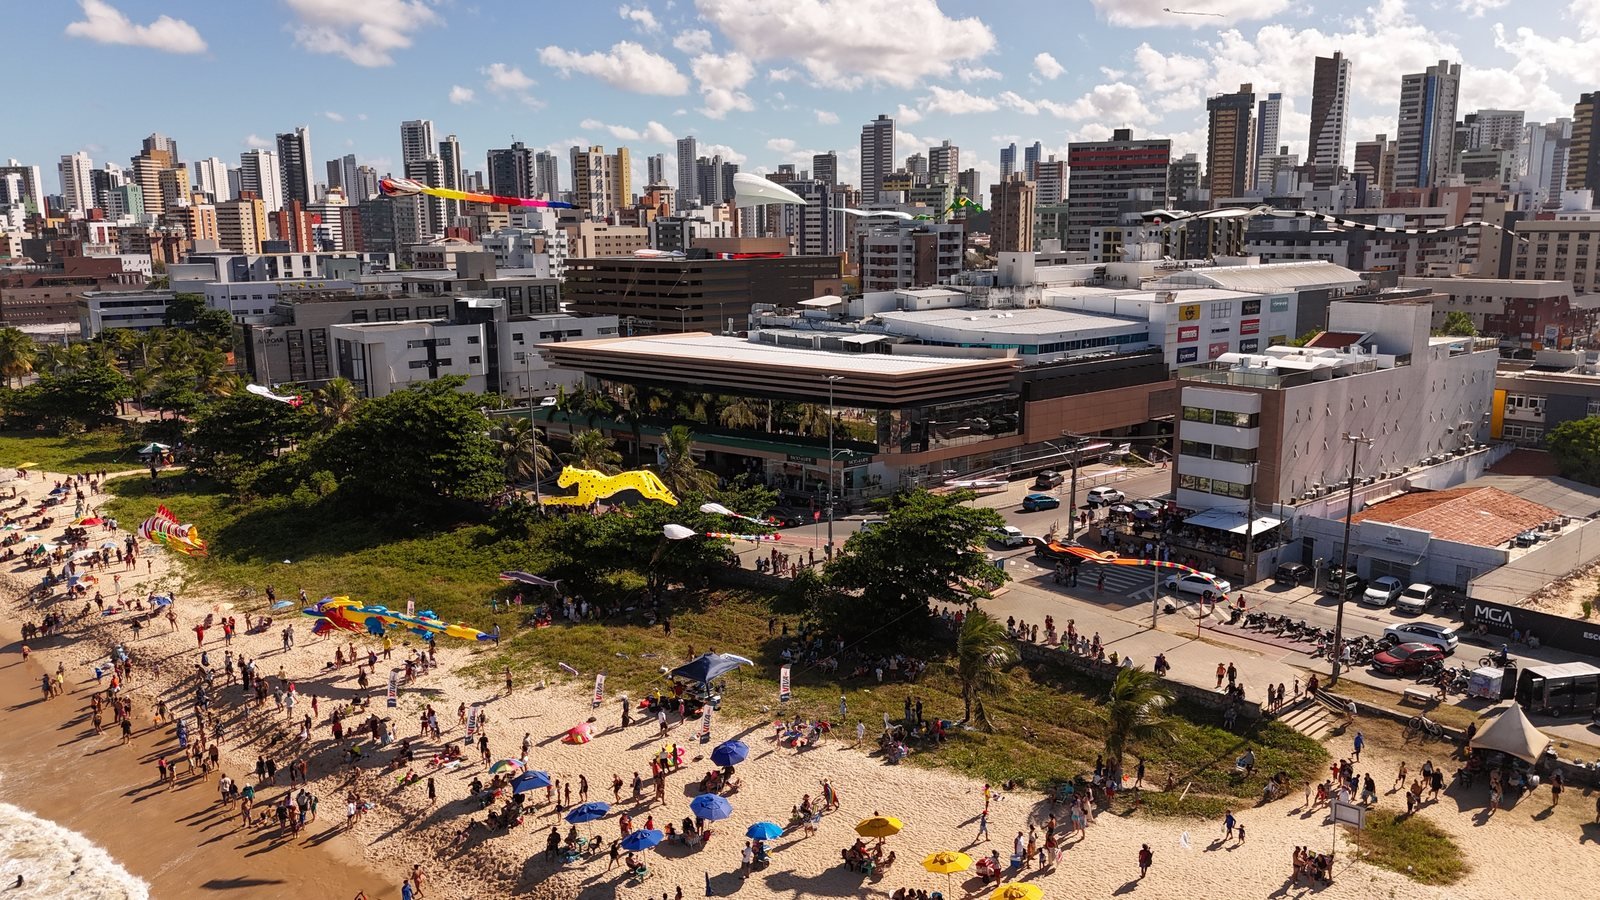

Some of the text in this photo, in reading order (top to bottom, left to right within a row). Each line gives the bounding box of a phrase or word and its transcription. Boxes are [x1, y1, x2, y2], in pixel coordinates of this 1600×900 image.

[1474, 604, 1513, 625] MGA
[467, 715, 476, 735] VIVA
[703, 714, 711, 732] VIVA
